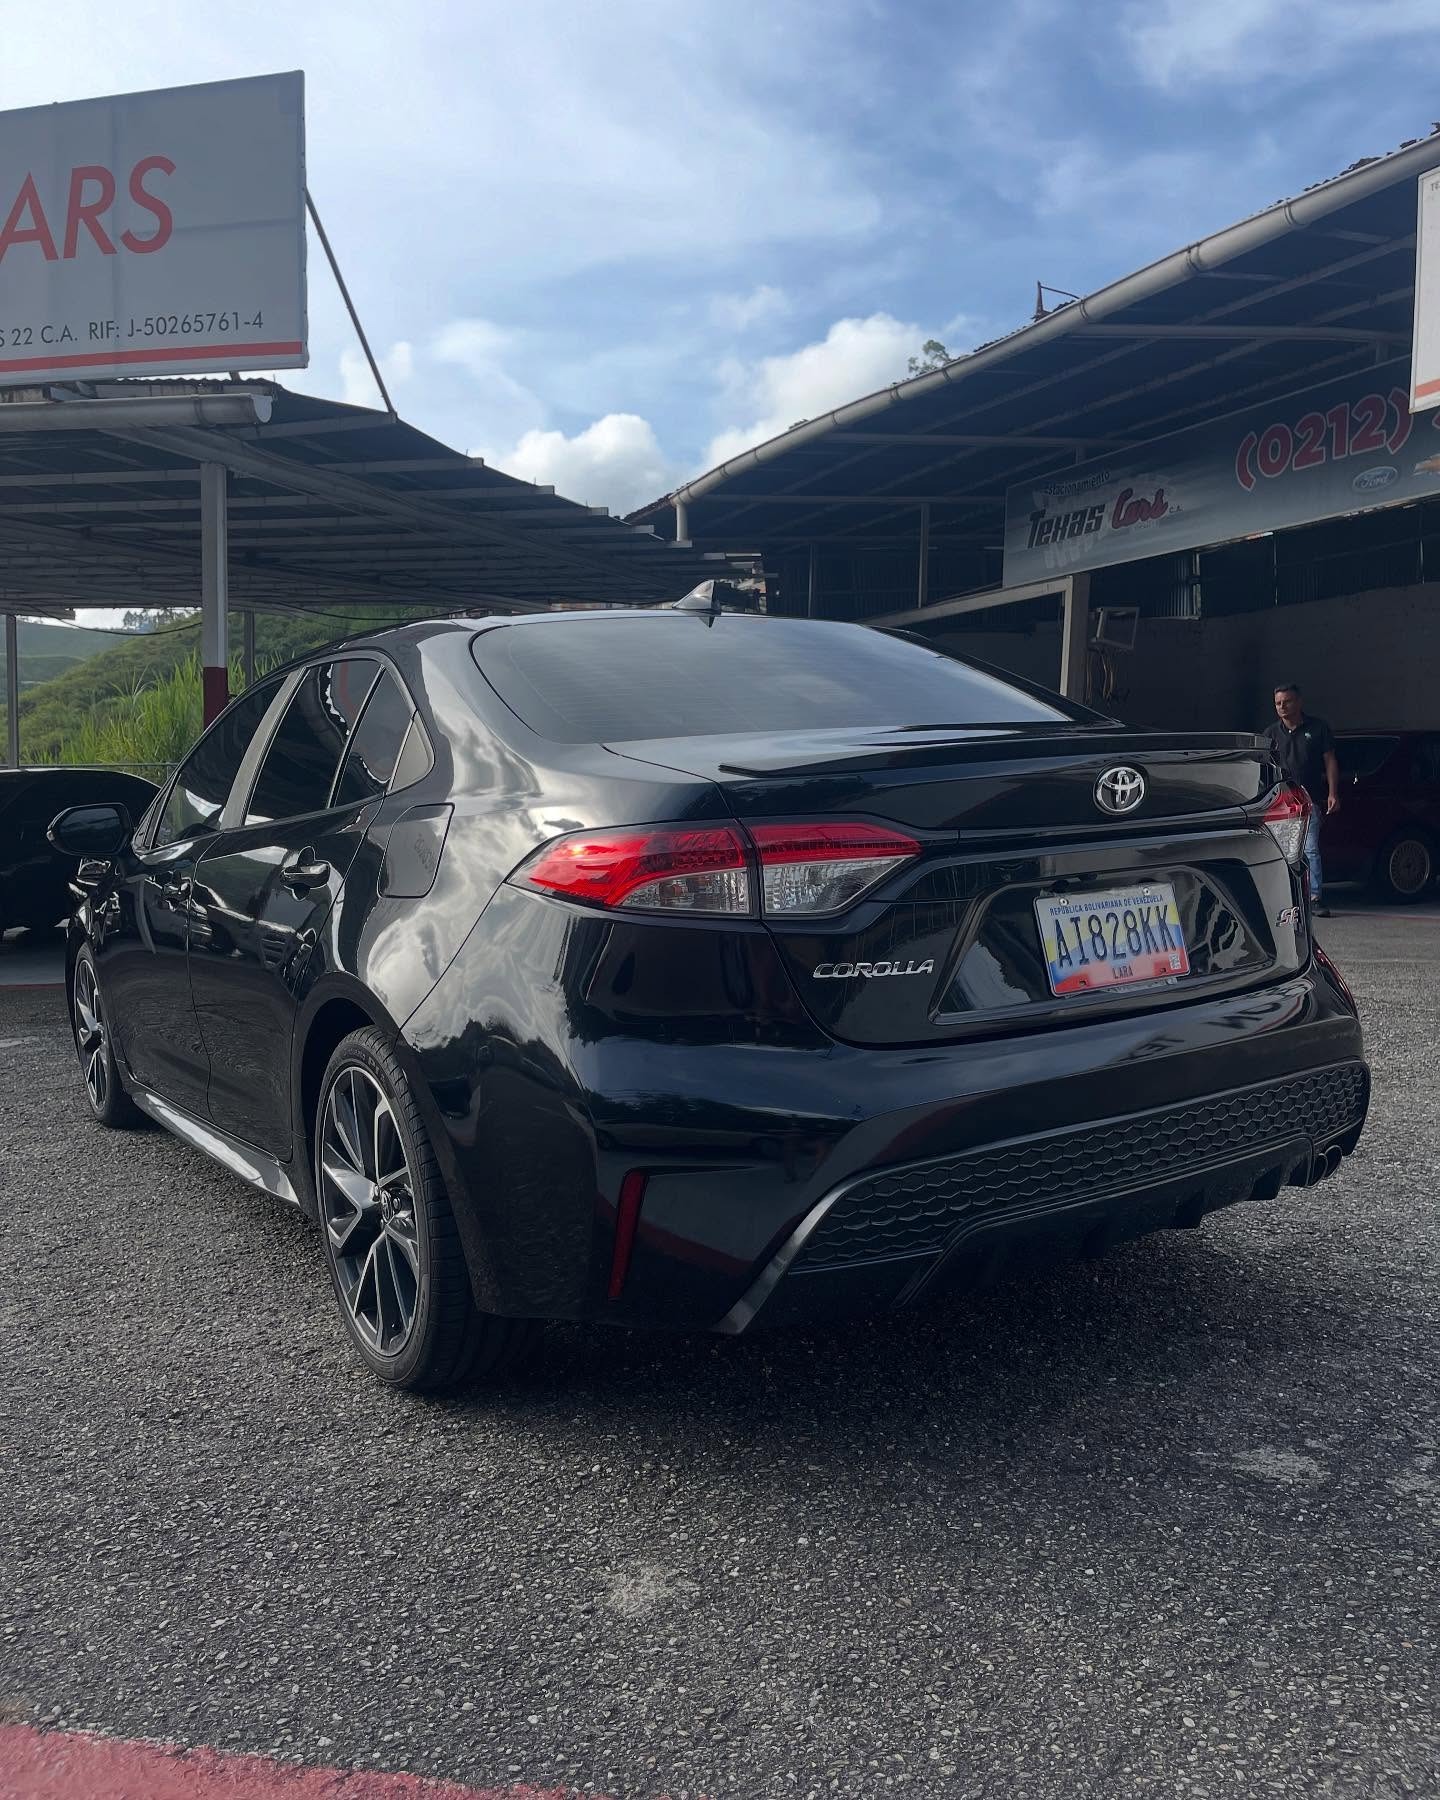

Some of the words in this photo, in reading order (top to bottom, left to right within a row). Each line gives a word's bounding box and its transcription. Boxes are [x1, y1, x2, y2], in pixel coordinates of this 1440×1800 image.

[11, 327, 33, 346] 22
[40, 325, 78, 344] C.A.
[89, 321, 120, 340] RIF:
[127, 310, 264, 338] J-50265761-4
[1236, 387, 1414, 492] (0212)
[1083, 899, 1122, 912] BOLIVARIANA
[1122, 898, 1133, 906] DE
[1133, 894, 1163, 905] VENEZUELA
[1054, 904, 1177, 969] AI828KK
[813, 959, 935, 979] COROLLA
[1112, 965, 1134, 980] LARA
